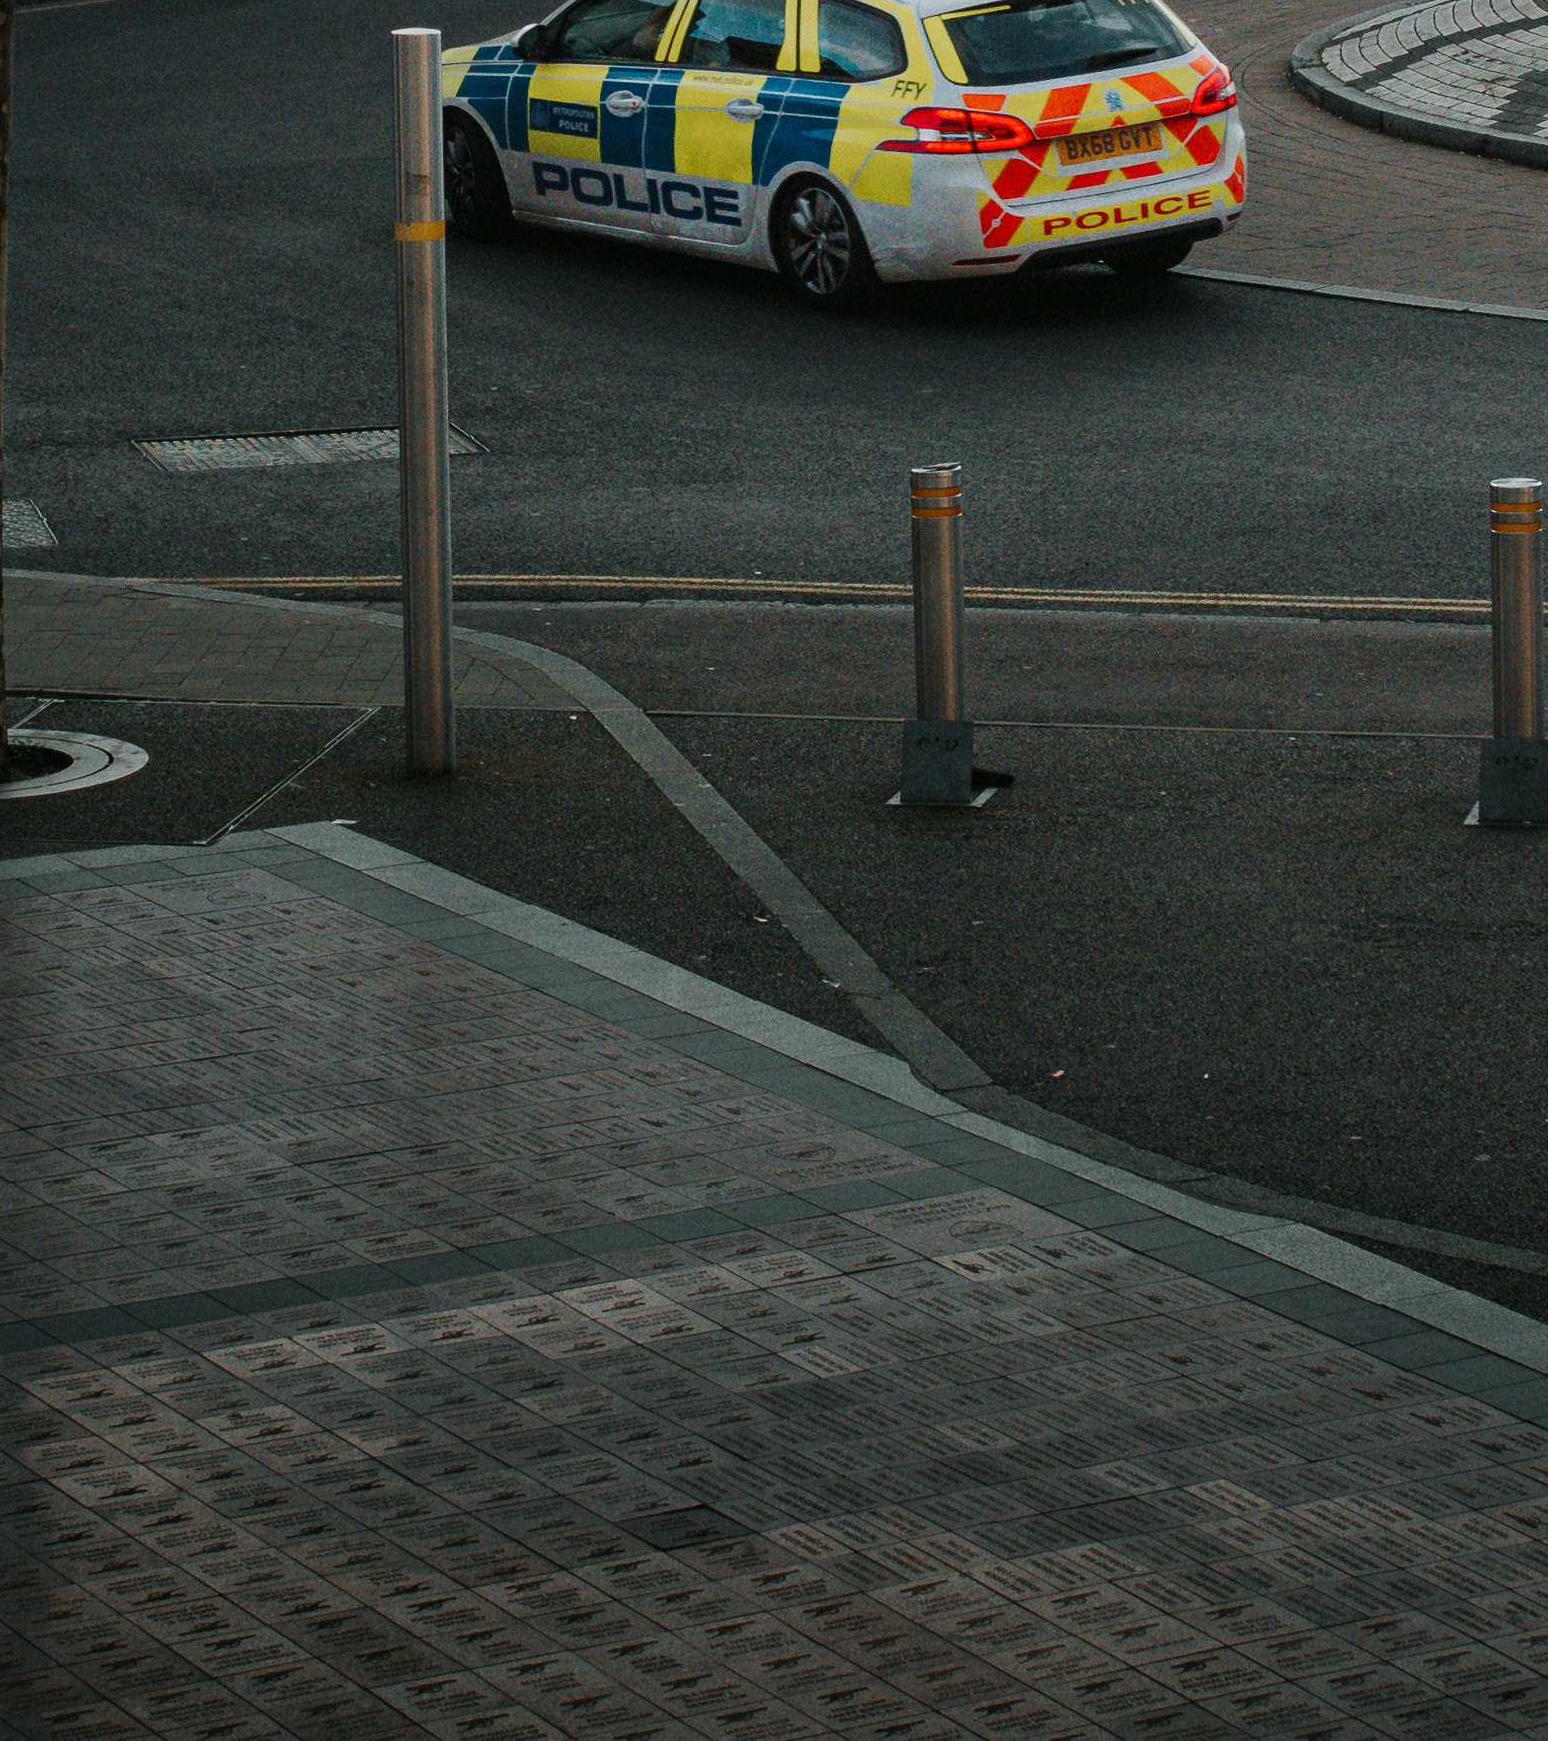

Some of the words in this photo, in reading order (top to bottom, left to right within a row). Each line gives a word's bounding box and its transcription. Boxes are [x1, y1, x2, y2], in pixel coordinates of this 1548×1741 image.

[890, 79, 928, 101] FFY
[552, 106, 596, 120] METROPOLITAN
[558, 119, 590, 133] POLICE
[1065, 132, 1116, 161] BX68
[1117, 126, 1153, 151] GVT
[531, 160, 743, 227] POLICE
[1043, 189, 1213, 236] POLICE
